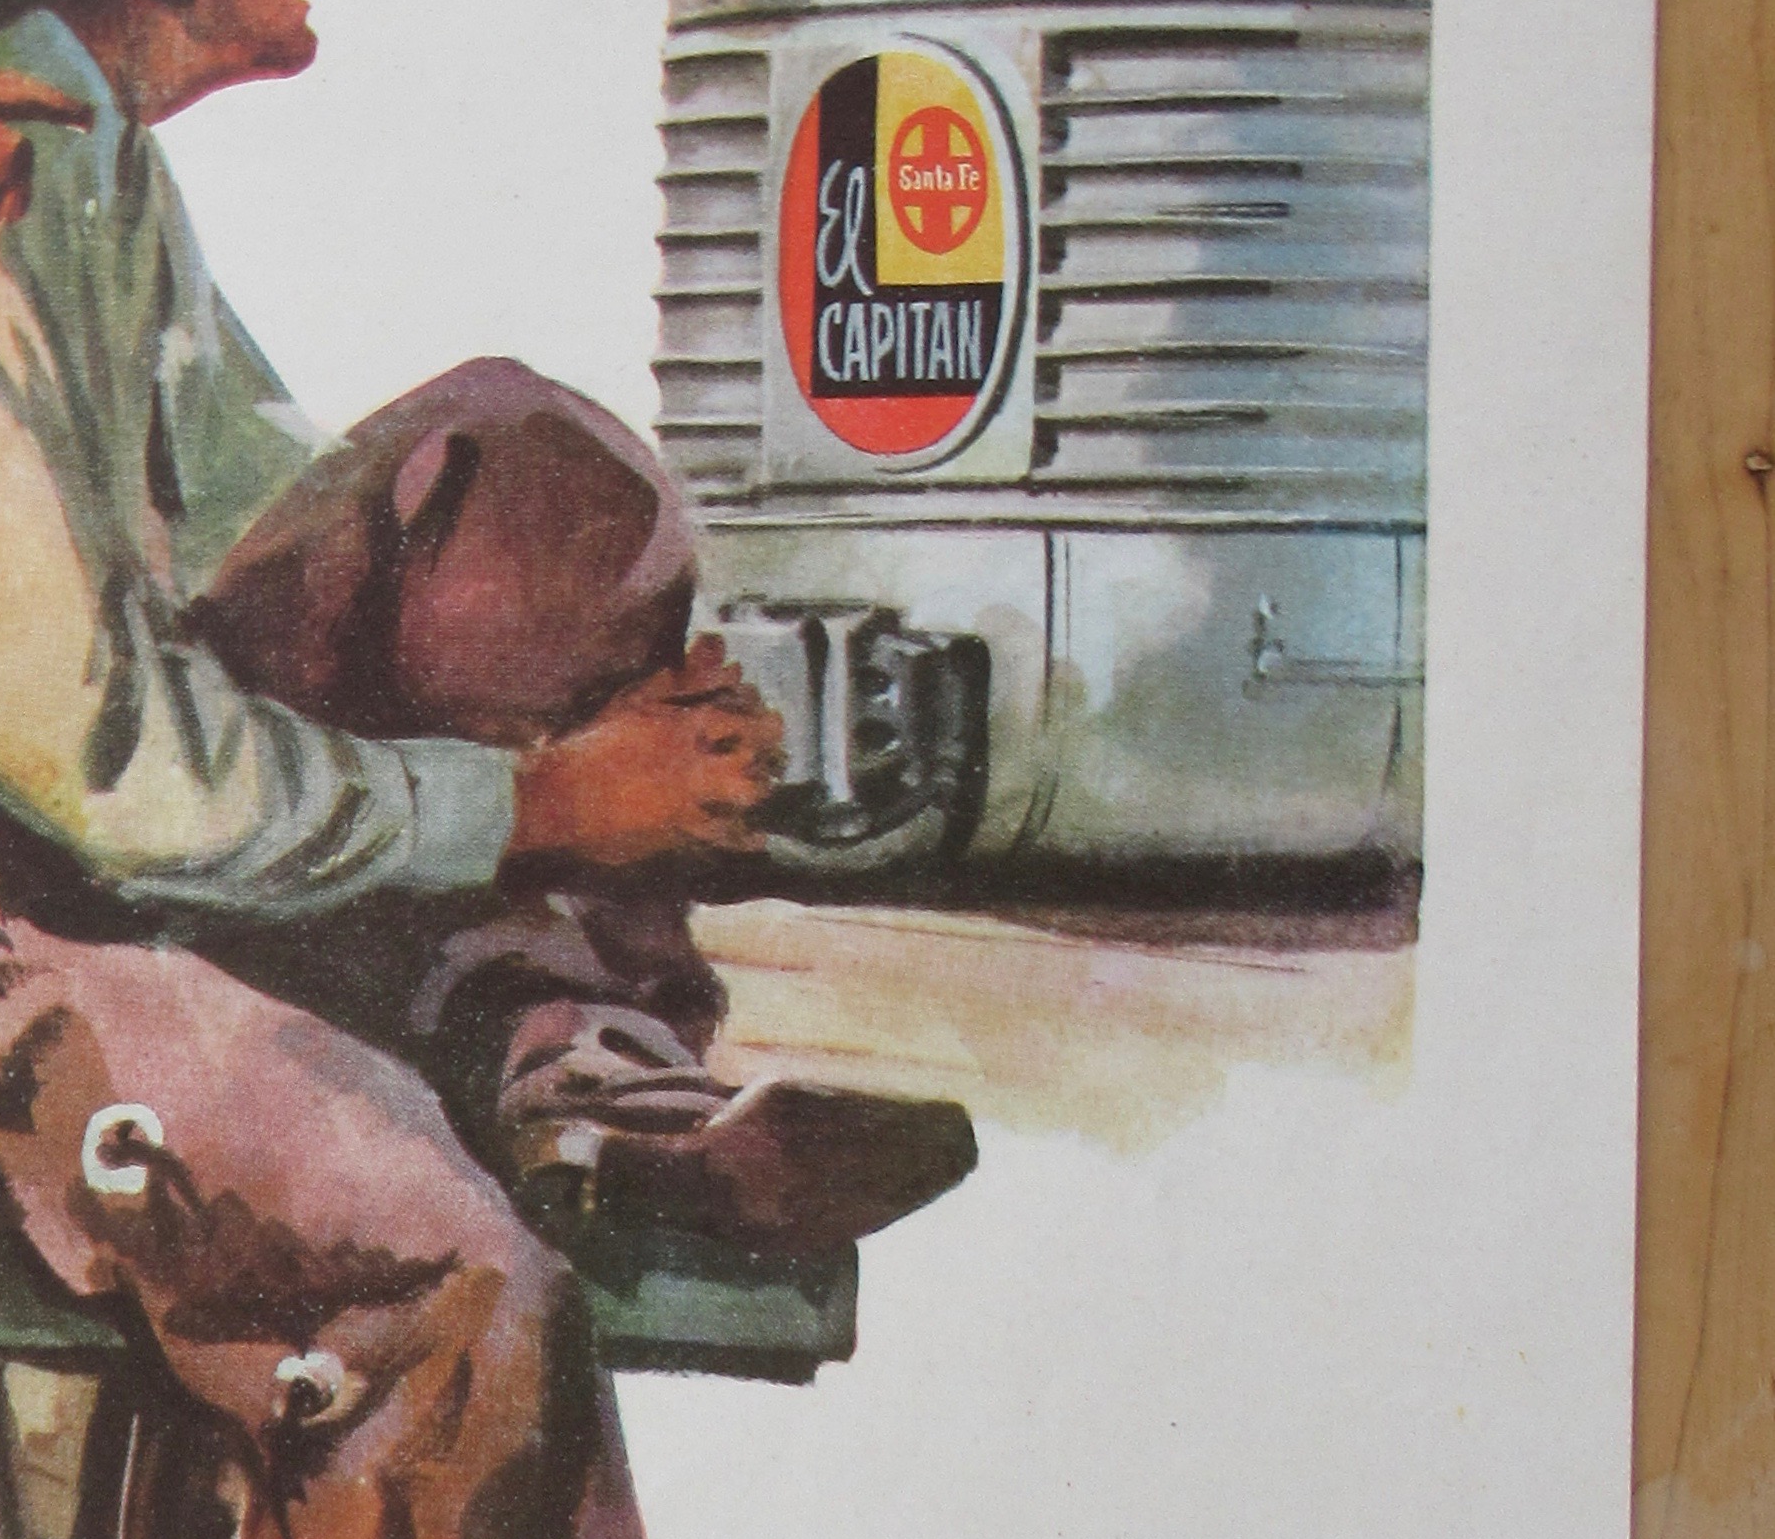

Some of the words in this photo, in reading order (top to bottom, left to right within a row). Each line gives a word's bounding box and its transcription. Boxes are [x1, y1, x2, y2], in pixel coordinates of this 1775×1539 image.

[899, 164, 954, 192] Santa
[958, 162, 981, 191] Fe
[815, 159, 874, 296] El
[818, 299, 982, 382] CAPITAN
